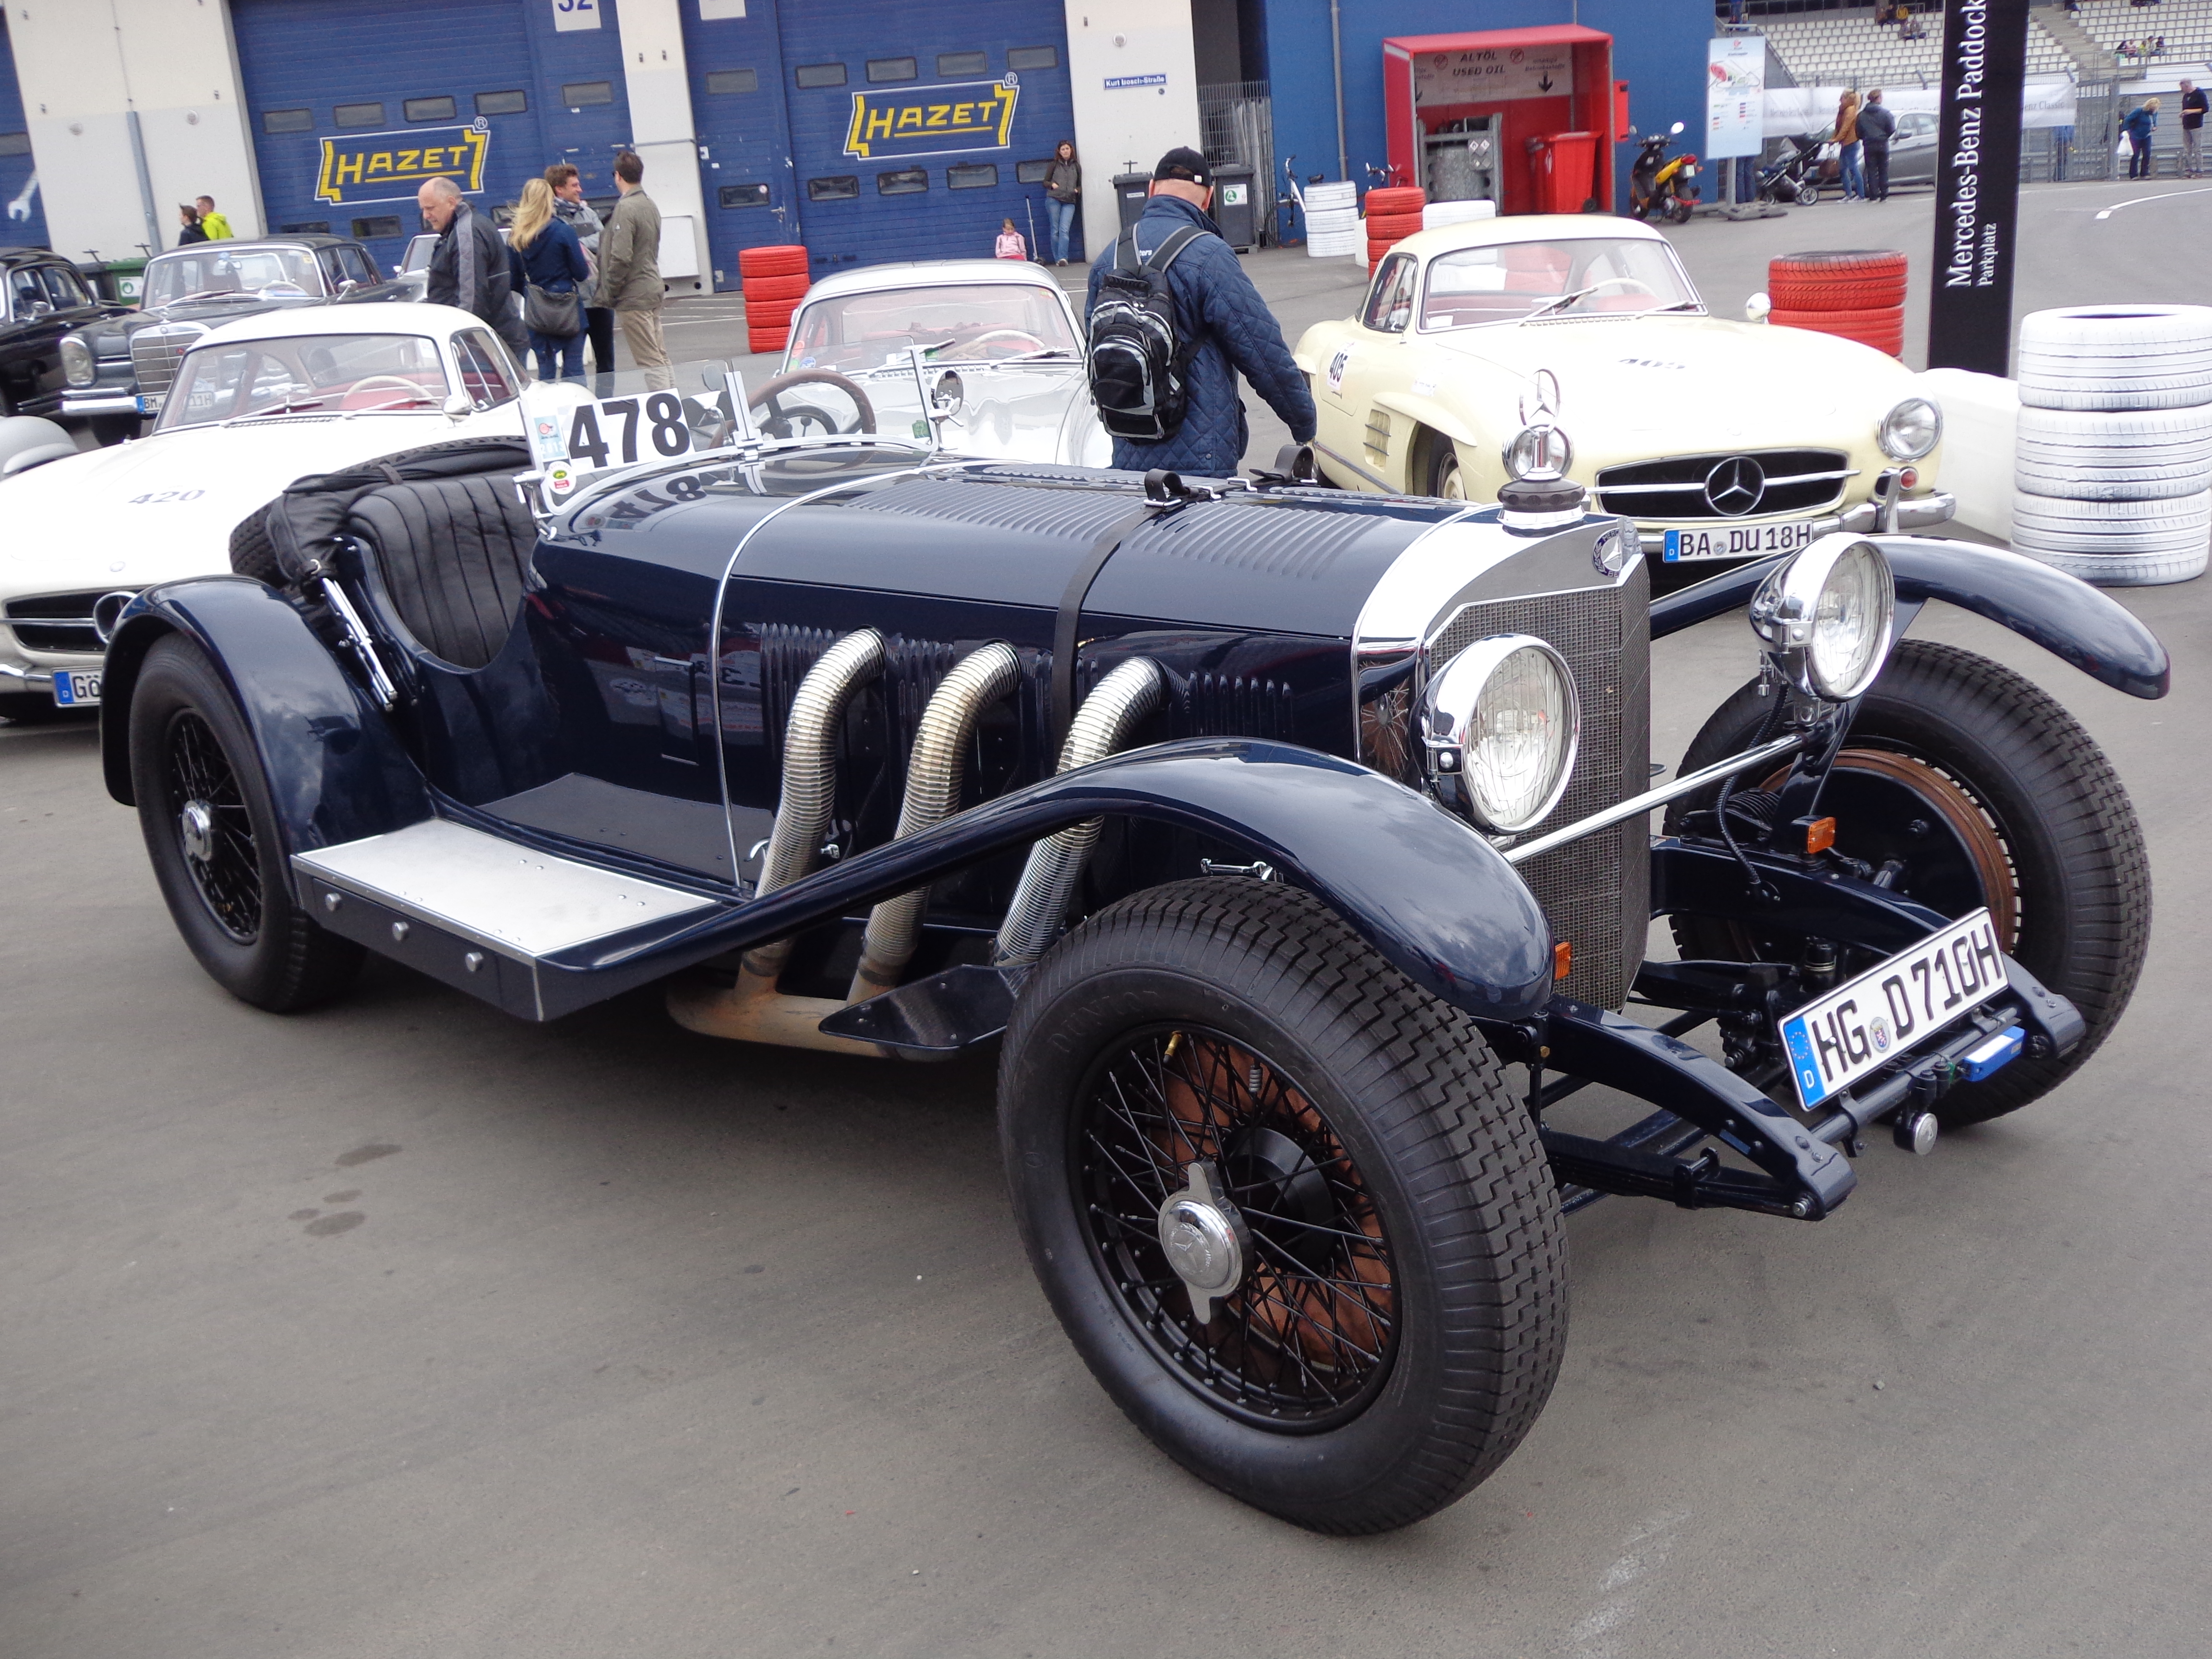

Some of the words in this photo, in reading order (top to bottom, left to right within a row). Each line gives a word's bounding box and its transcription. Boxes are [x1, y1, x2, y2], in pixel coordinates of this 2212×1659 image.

[1460, 49, 1498, 62] ALTÖL
[1956, 0, 1987, 101] Paddock
[1453, 66, 1482, 76] USED
[1486, 64, 1506, 74] OIL
[866, 100, 998, 140] HAZET
[2040, 100, 2065, 110] Classic
[336, 145, 469, 185] HAZET
[1945, 107, 1982, 288] Mercedes-Benz
[1976, 223, 1999, 287] Parkplatz
[1329, 351, 1348, 383] 405
[144, 397, 157, 409] BM
[568, 392, 691, 469] 478
[127, 489, 205, 504] 420
[1680, 532, 1711, 556] BA
[1729, 528, 1761, 553] DU
[1766, 523, 1811, 551] 18H
[72, 674, 102, 698] GÖ
[1803, 1070, 1815, 1089] D
[1811, 998, 1872, 1082] HG
[1881, 974, 1915, 1040] D
[1910, 923, 2003, 1022] 710H
